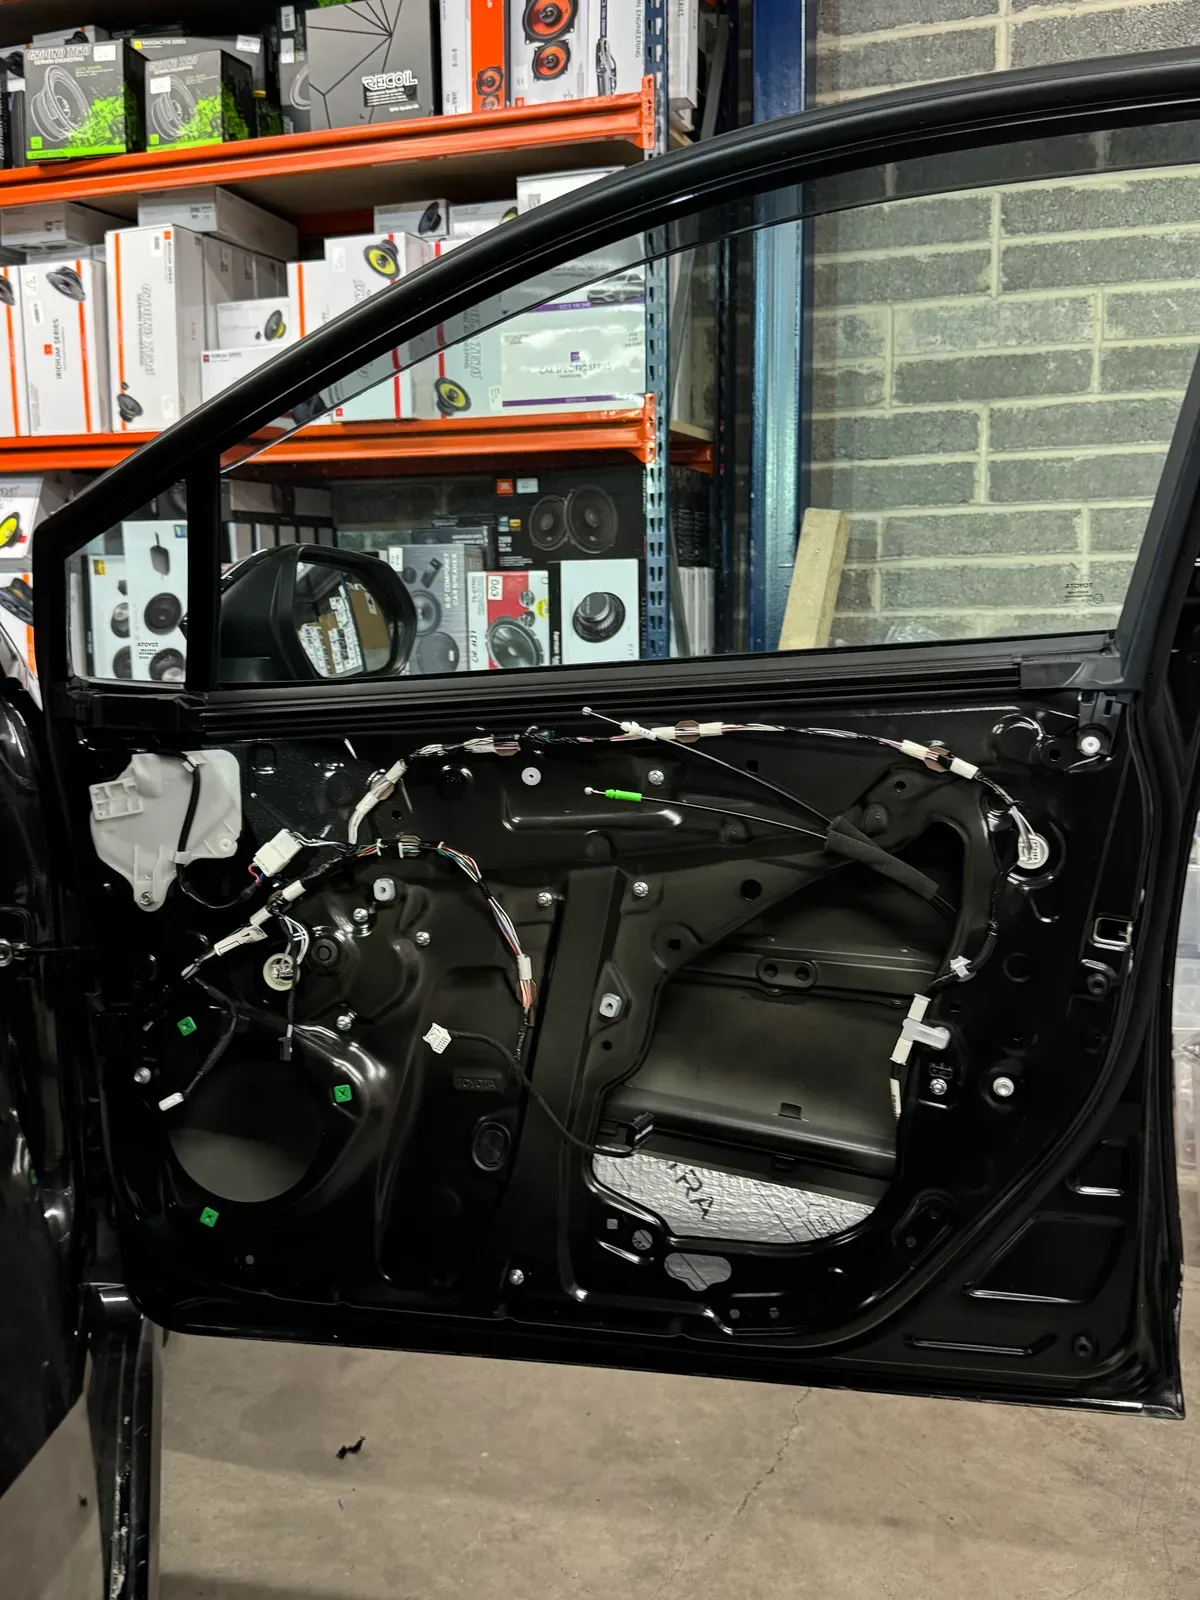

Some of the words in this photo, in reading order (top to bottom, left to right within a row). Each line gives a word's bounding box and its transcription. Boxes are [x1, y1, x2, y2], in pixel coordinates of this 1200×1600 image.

[361, 69, 418, 91] RECOIL
[52, 318, 61, 344] SERIES
[456, 1078, 497, 1089] TOYOTA
